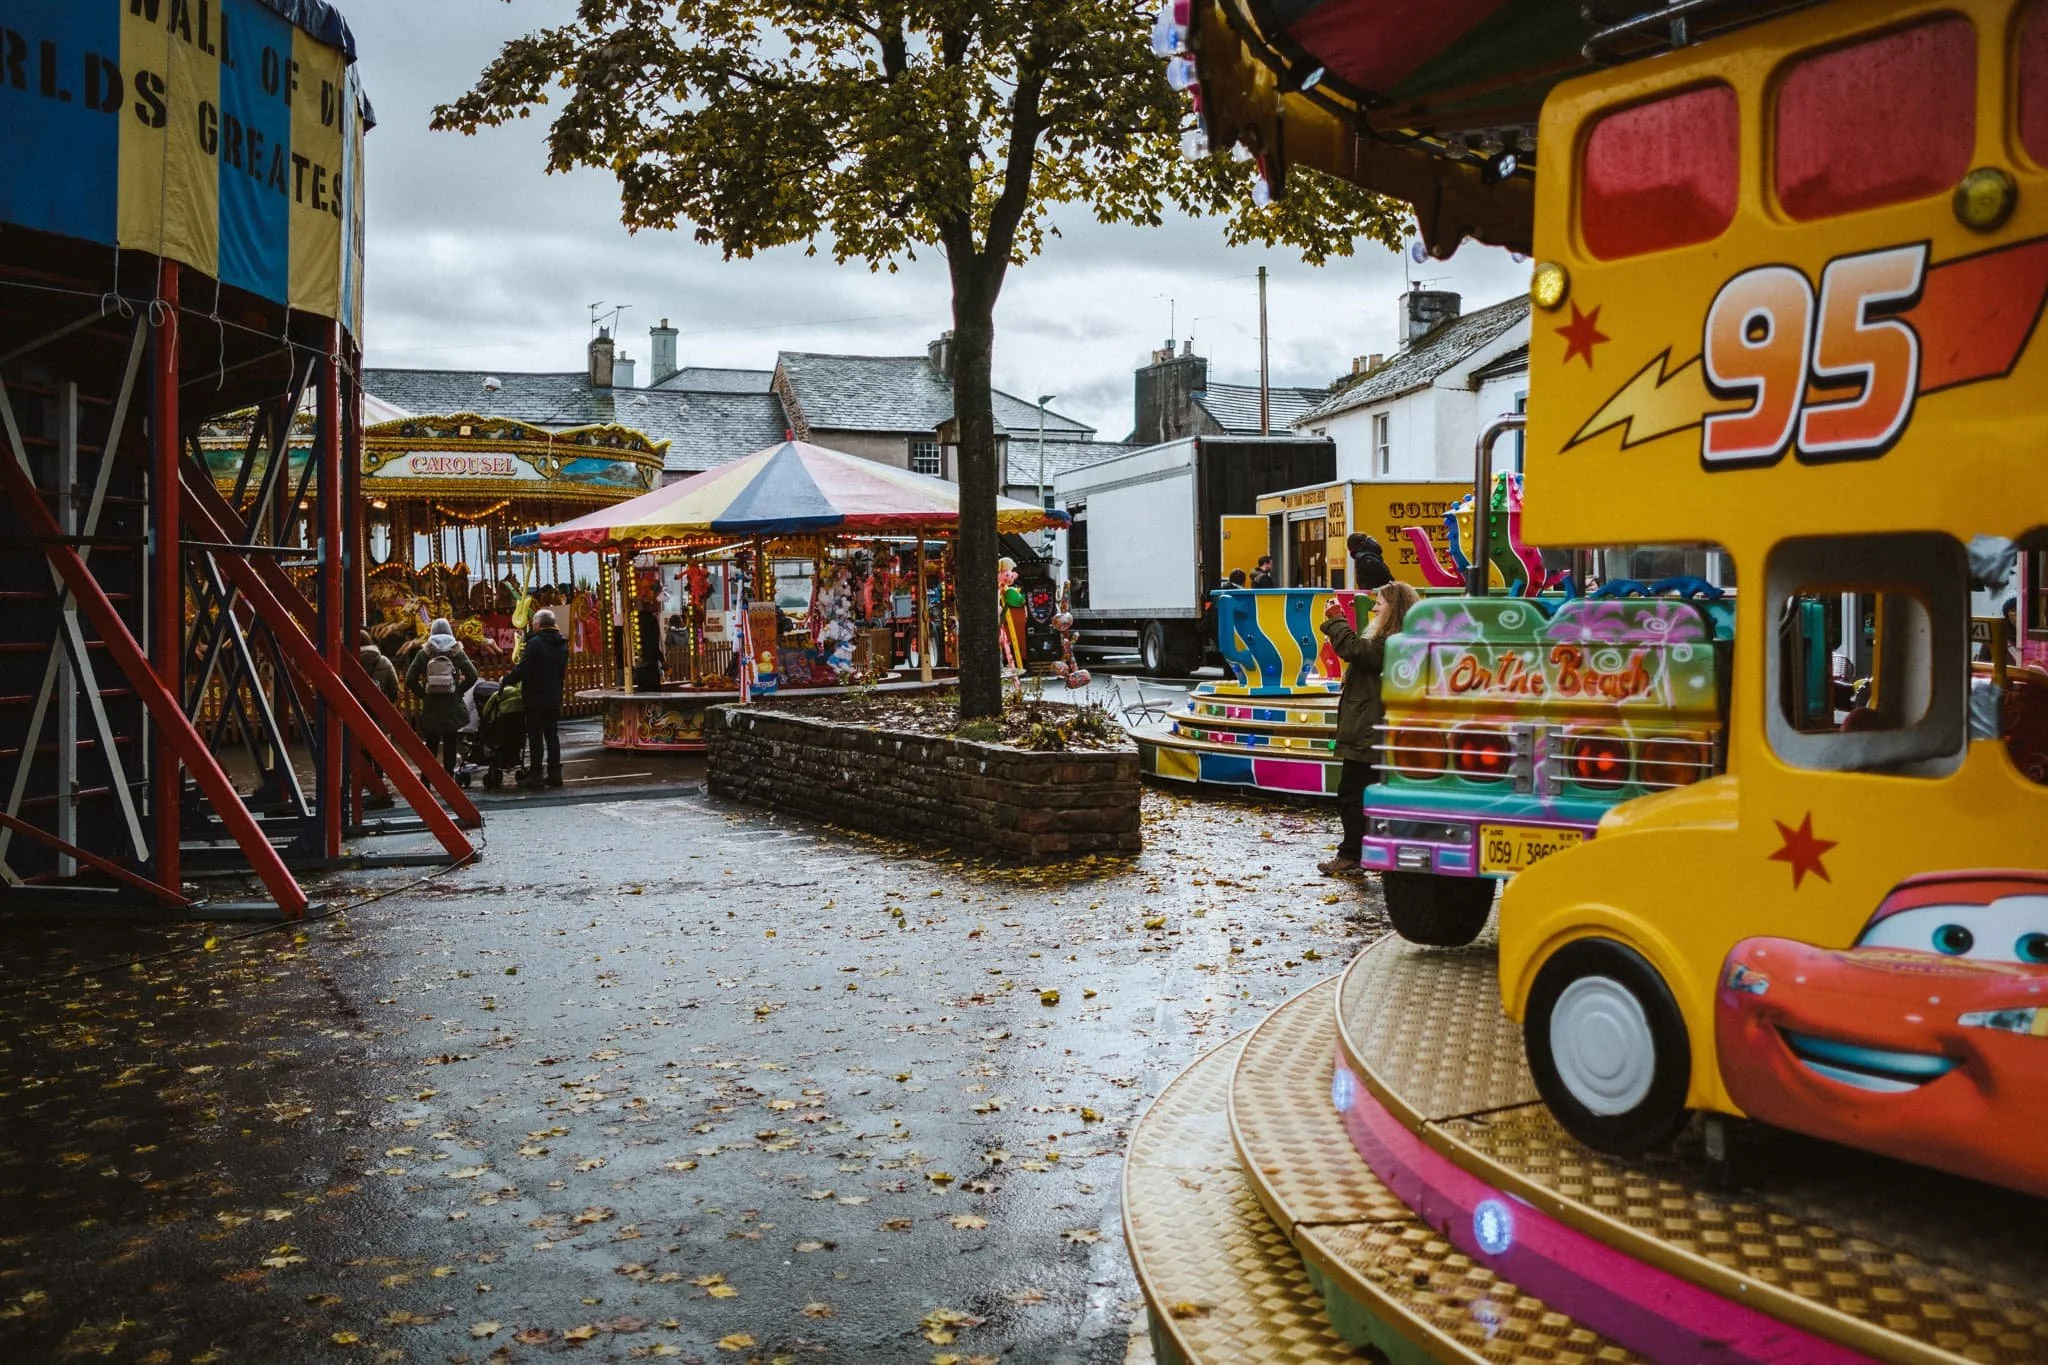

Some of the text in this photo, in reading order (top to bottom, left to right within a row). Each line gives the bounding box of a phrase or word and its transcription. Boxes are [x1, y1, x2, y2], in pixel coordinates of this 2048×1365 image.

[261, 45, 299, 108] OF
[198, 100, 344, 222] GREATES
[1700, 239, 1932, 473] 95
[408, 455, 518, 476] CAROUSEL
[1303, 491, 1316, 504] TICKETS
[1317, 488, 1326, 503] HERE
[1329, 501, 1345, 518] OPEN
[1389, 502, 1456, 518] GOIN
[1328, 521, 1346, 538] DAILY
[1450, 643, 1653, 699] On the Beach
[1489, 840, 1511, 864] 059
[1526, 843, 1572, 865] 386
